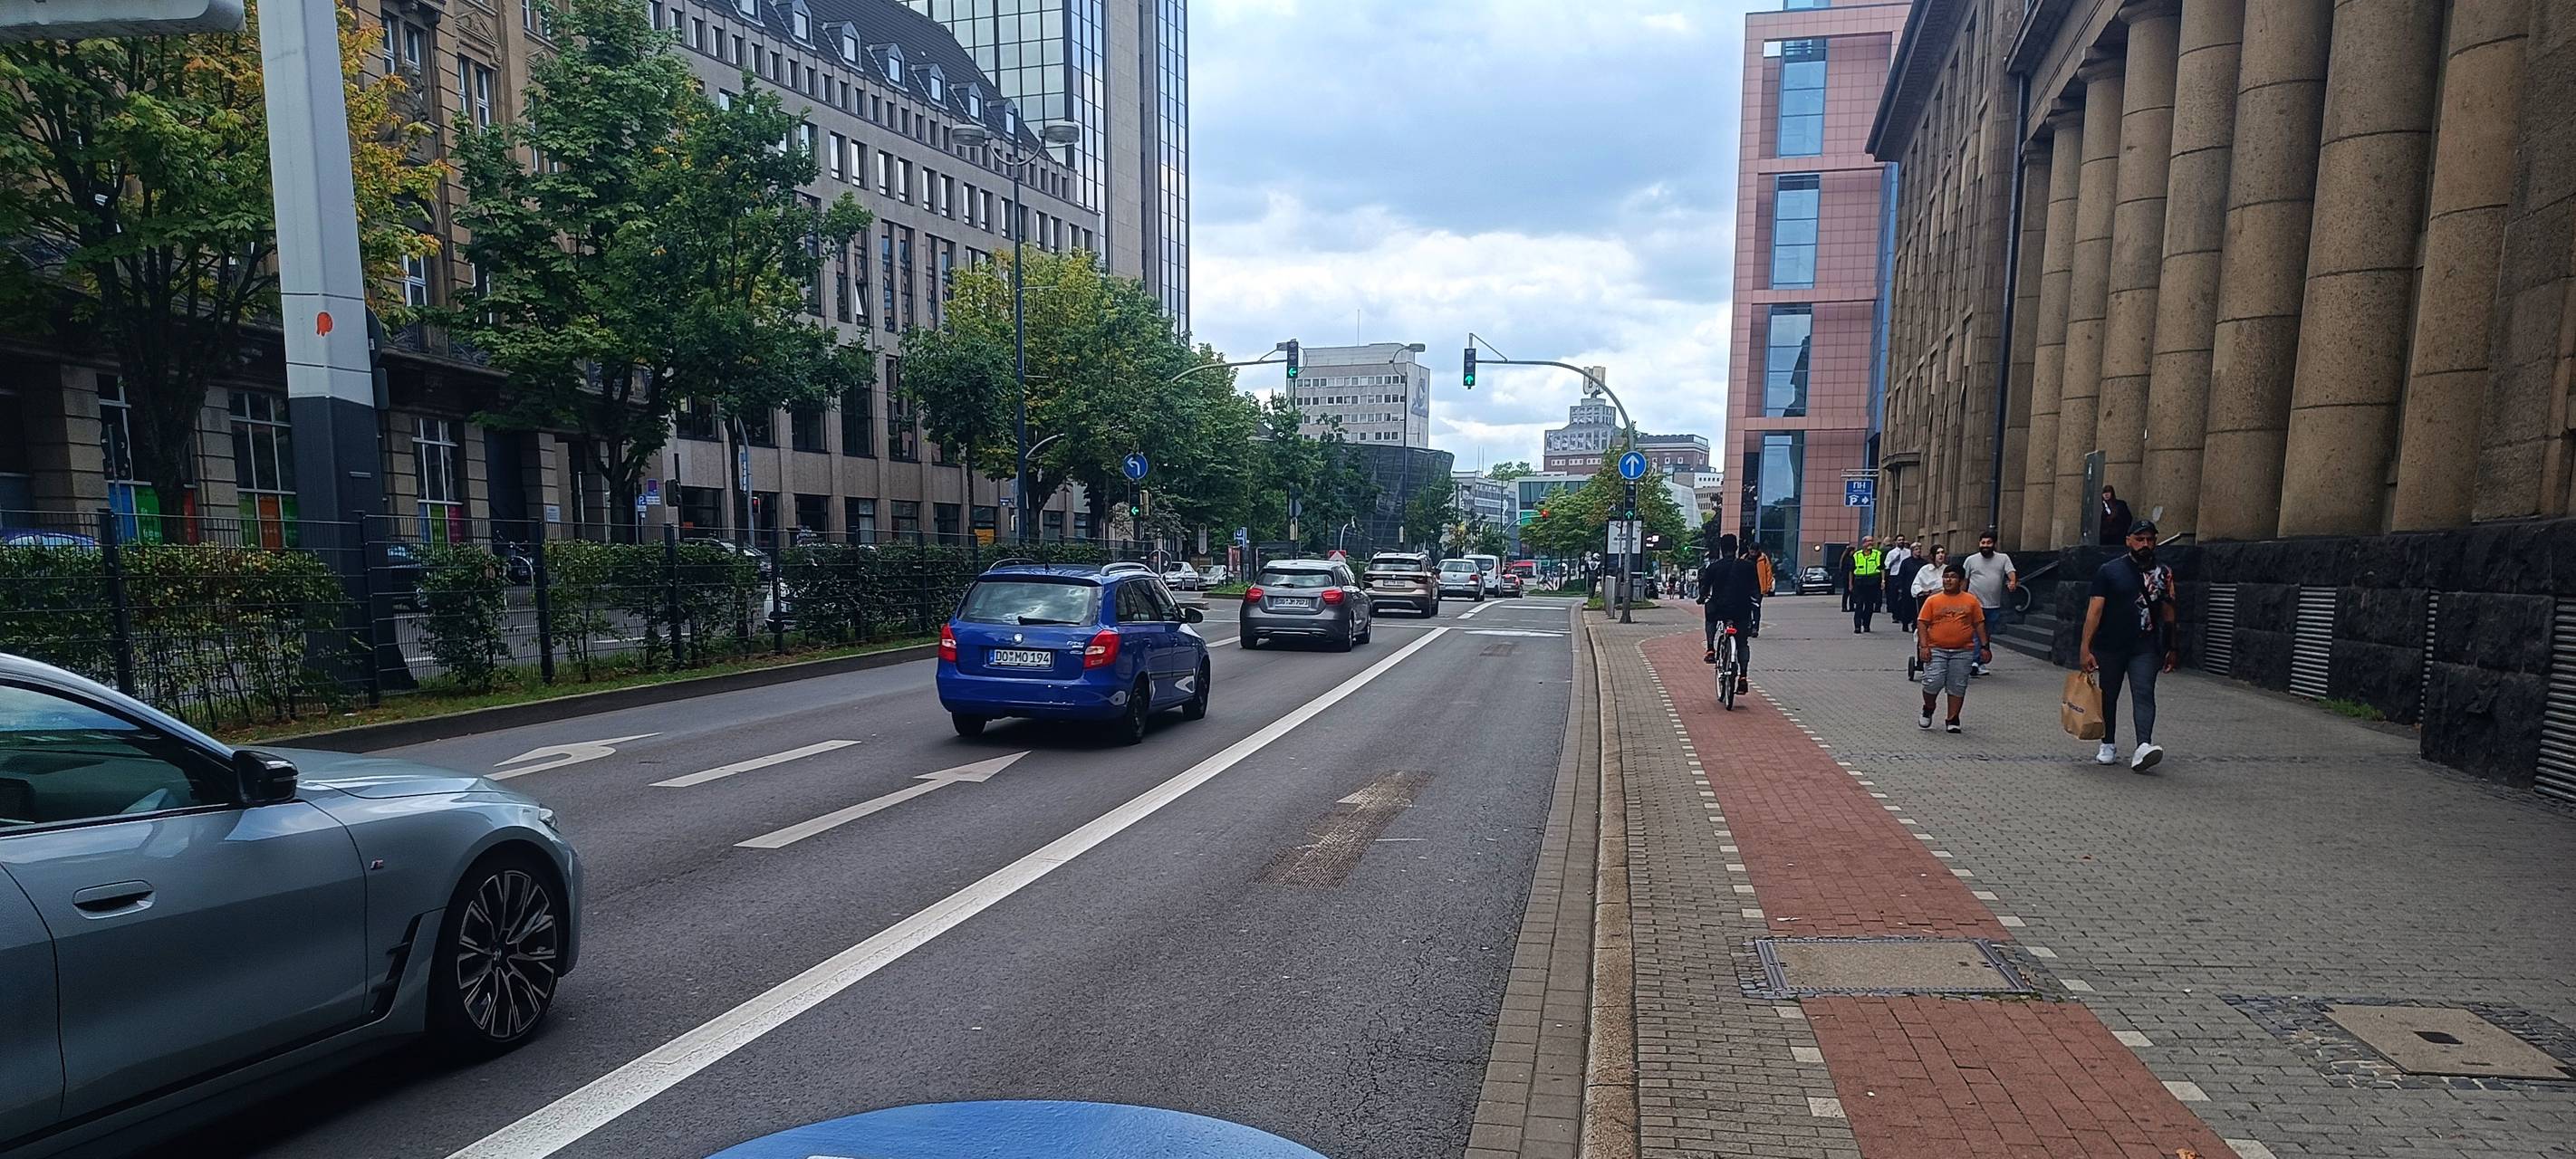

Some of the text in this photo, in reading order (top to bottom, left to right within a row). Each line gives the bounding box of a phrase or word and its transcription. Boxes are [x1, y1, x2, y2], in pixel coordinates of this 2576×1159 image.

[995, 650, 1050, 664] DO MO 194
